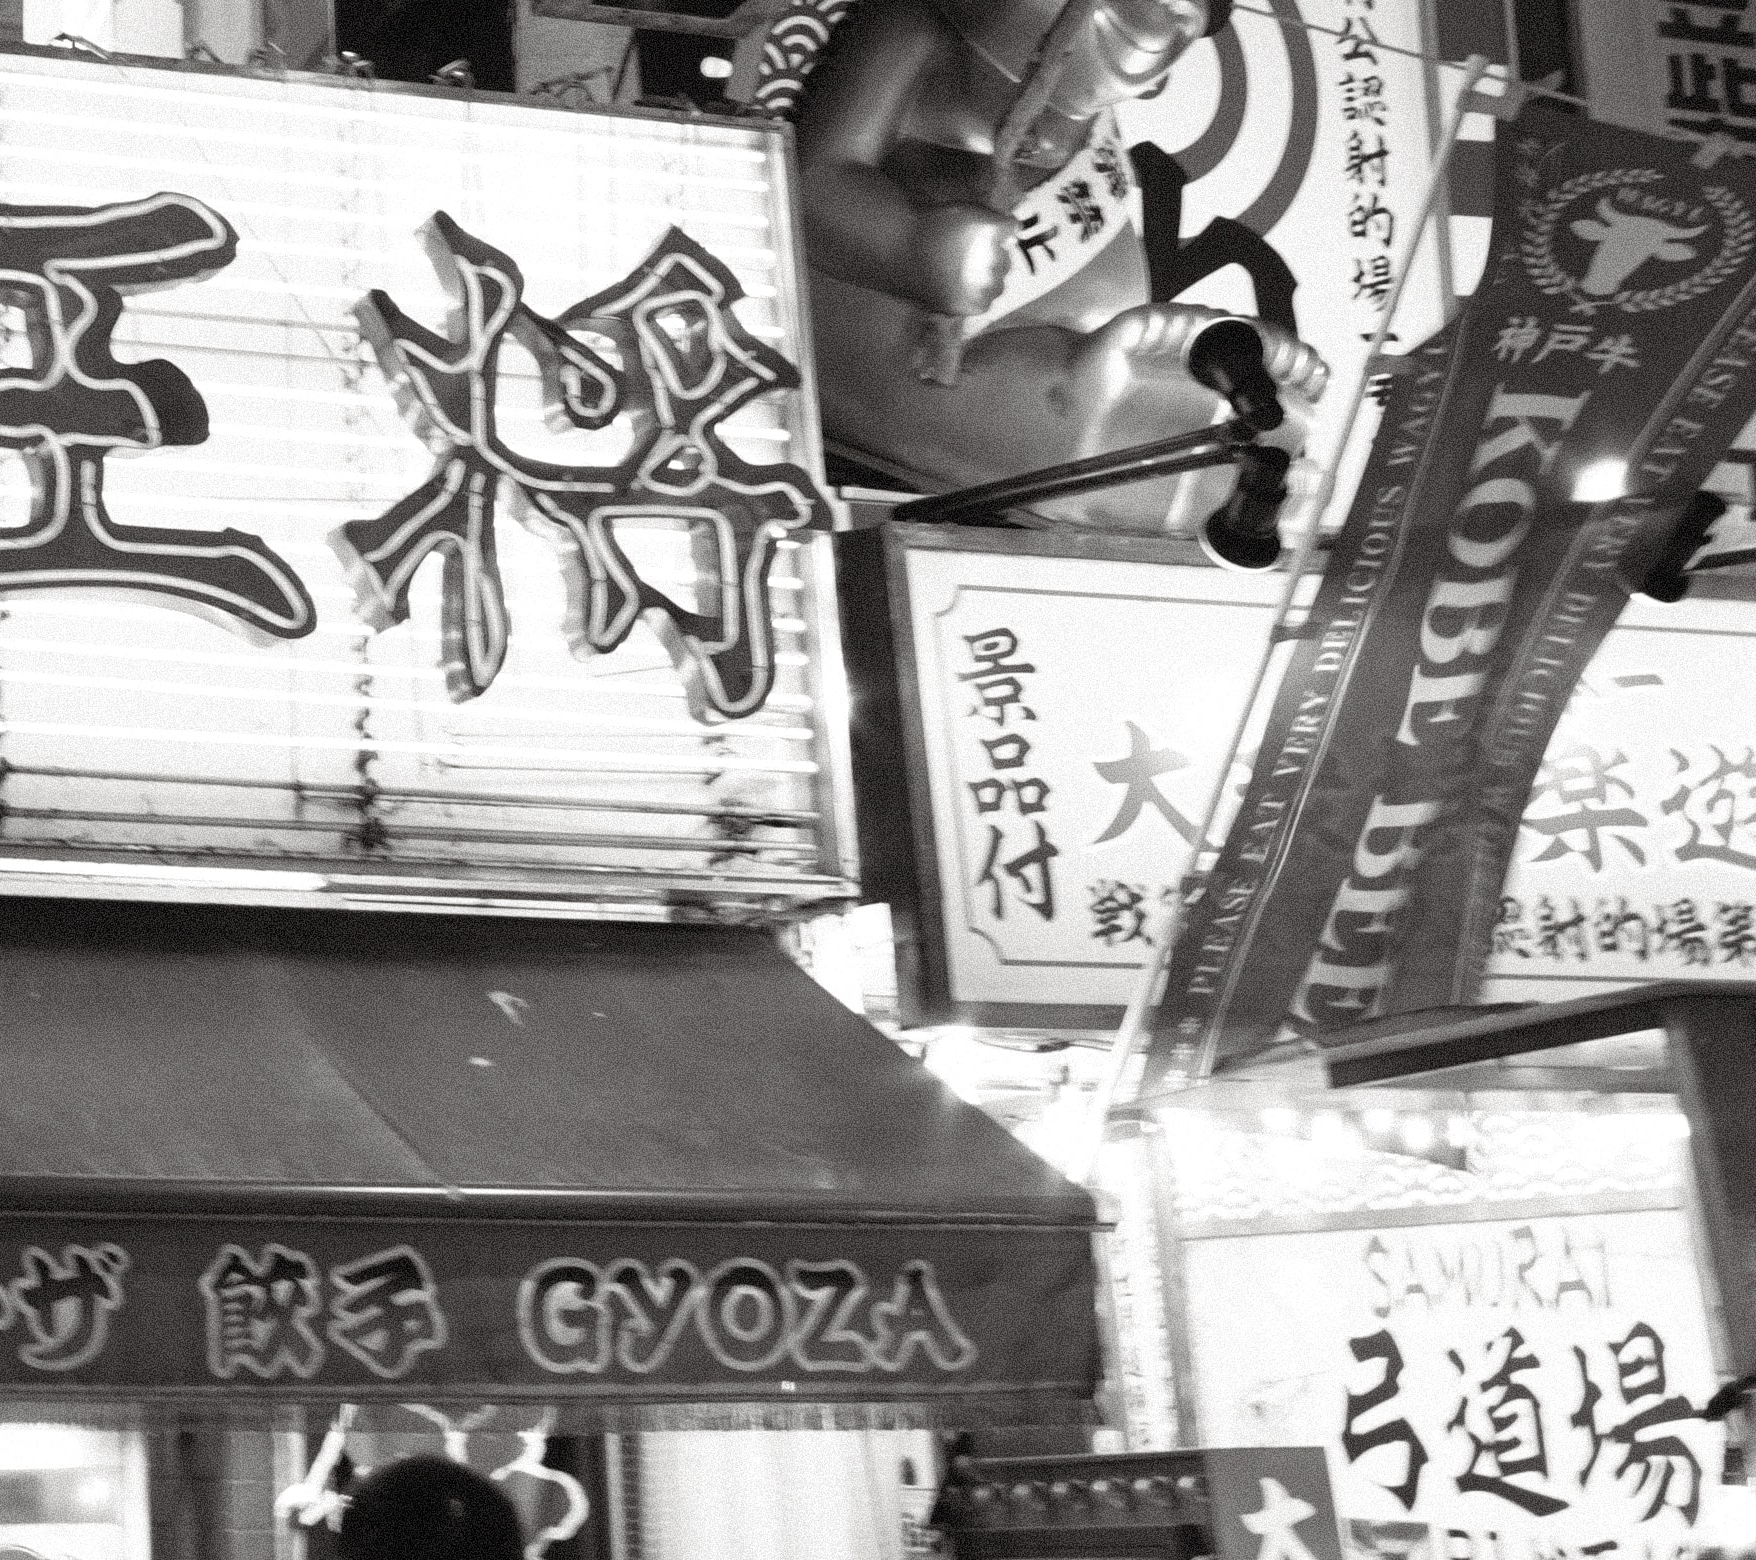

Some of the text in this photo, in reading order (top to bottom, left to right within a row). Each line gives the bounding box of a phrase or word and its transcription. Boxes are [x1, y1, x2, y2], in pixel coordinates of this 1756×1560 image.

[1493, 315, 1642, 375] 神戸牛
[1272, 688, 1330, 778] VERY
[1311, 484, 1403, 672] DELICIOUS
[1276, 383, 1592, 1044] KOBE BEE
[958, 627, 1060, 922] 景品付
[200, 1243, 447, 1378] 餃子
[517, 1257, 979, 1375] GYOZA
[1362, 1224, 1613, 1320] SAMURAI
[1341, 1320, 1706, 1529] 弓道場
